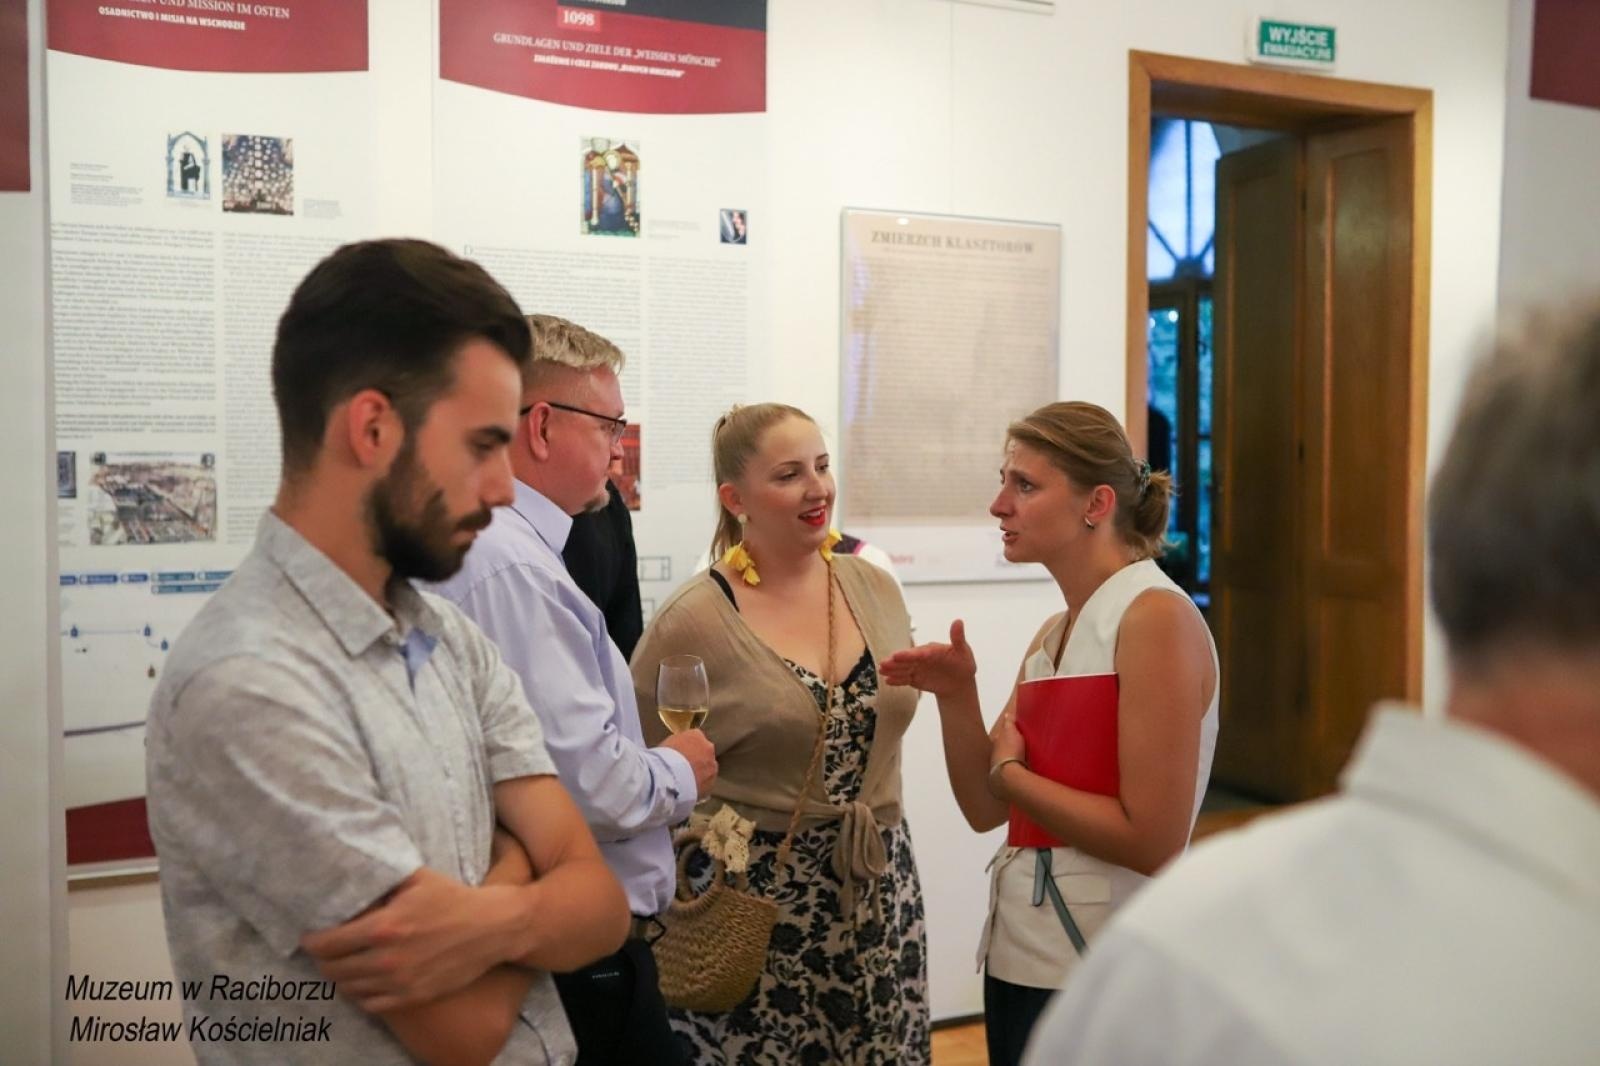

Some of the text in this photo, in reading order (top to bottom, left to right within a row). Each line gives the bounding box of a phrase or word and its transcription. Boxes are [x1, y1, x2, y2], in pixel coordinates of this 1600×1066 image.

[98, 6, 155, 20] OSADNICTWO
[160, 13, 185, 24] MISJA
[185, 16, 199, 26] NA
[199, 17, 246, 31] WSCHODZIE
[187, 0, 235, 13] MISSION
[237, 3, 252, 15] IM
[253, 4, 290, 19] OSTEN
[563, 9, 596, 27] 1098
[493, 32, 561, 50] GRUNDLAGEN
[562, 40, 584, 52] UND
[585, 42, 612, 56] ZIELE
[613, 46, 633, 58] DER
[871, 230, 941, 248] ZMIERZCH
